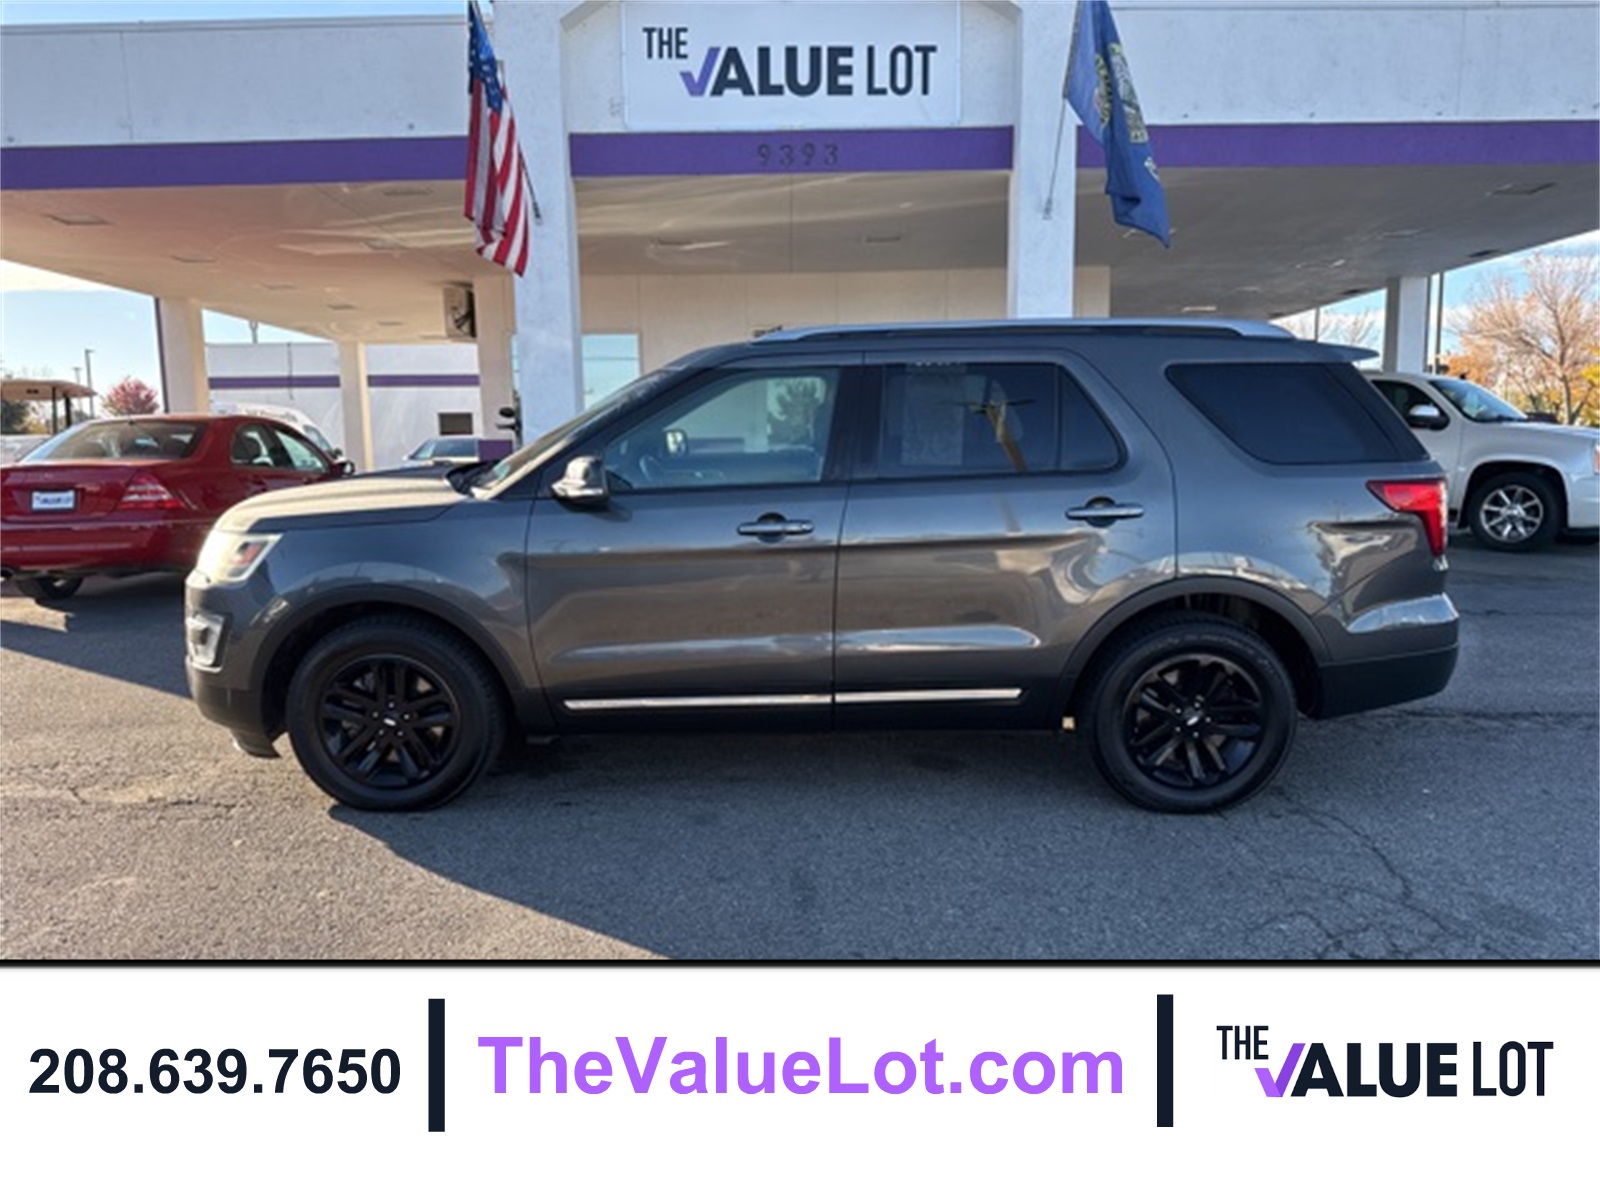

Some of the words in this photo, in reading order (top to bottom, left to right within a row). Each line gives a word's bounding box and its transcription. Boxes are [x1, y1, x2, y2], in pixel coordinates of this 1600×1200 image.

[642, 27, 688, 59] THE
[679, 46, 854, 97] VALUE
[867, 45, 938, 96] LOT
[757, 143, 839, 166] 9393
